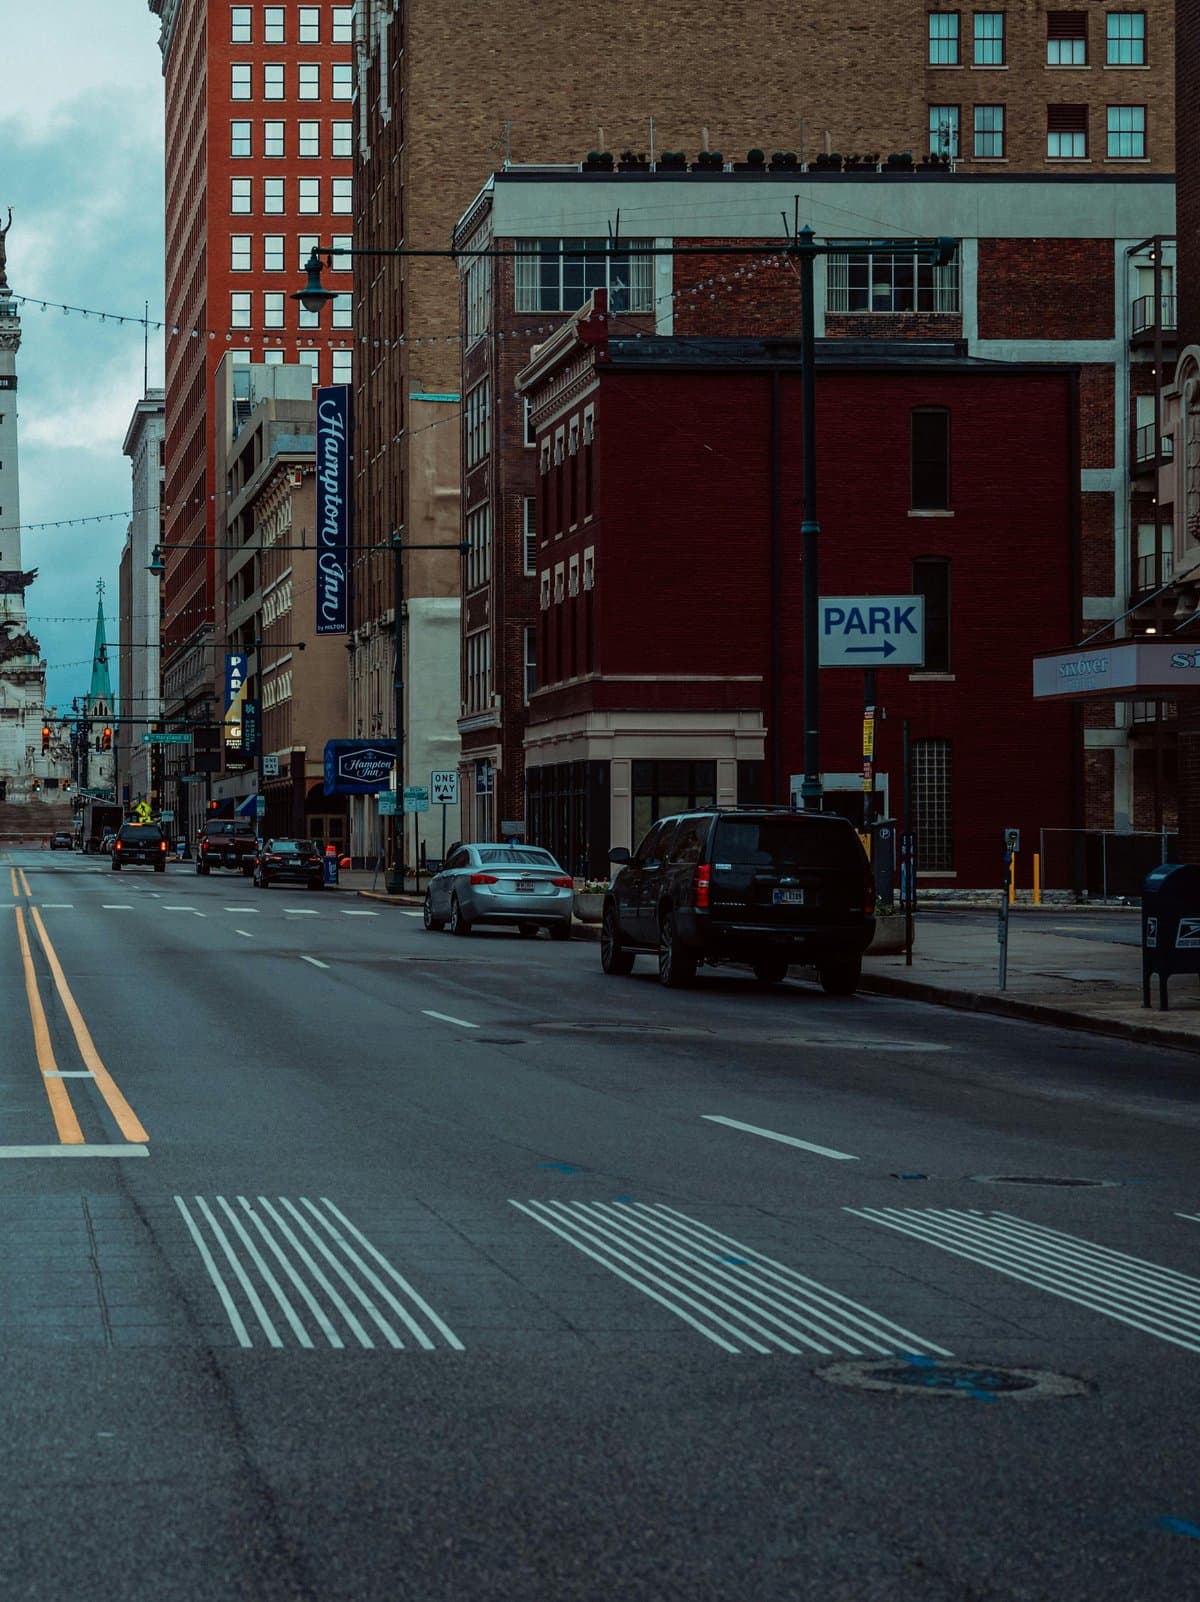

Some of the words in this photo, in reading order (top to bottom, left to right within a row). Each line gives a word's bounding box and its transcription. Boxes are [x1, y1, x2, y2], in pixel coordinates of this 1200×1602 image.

[319, 400, 344, 546] Hampton
[319, 552, 344, 621] Inn
[824, 606, 918, 635] PARK
[344, 759, 392, 771] Hampton
[357, 767, 383, 777] Inn
[435, 774, 455, 782] ONE
[434, 784, 455, 793] WAY
